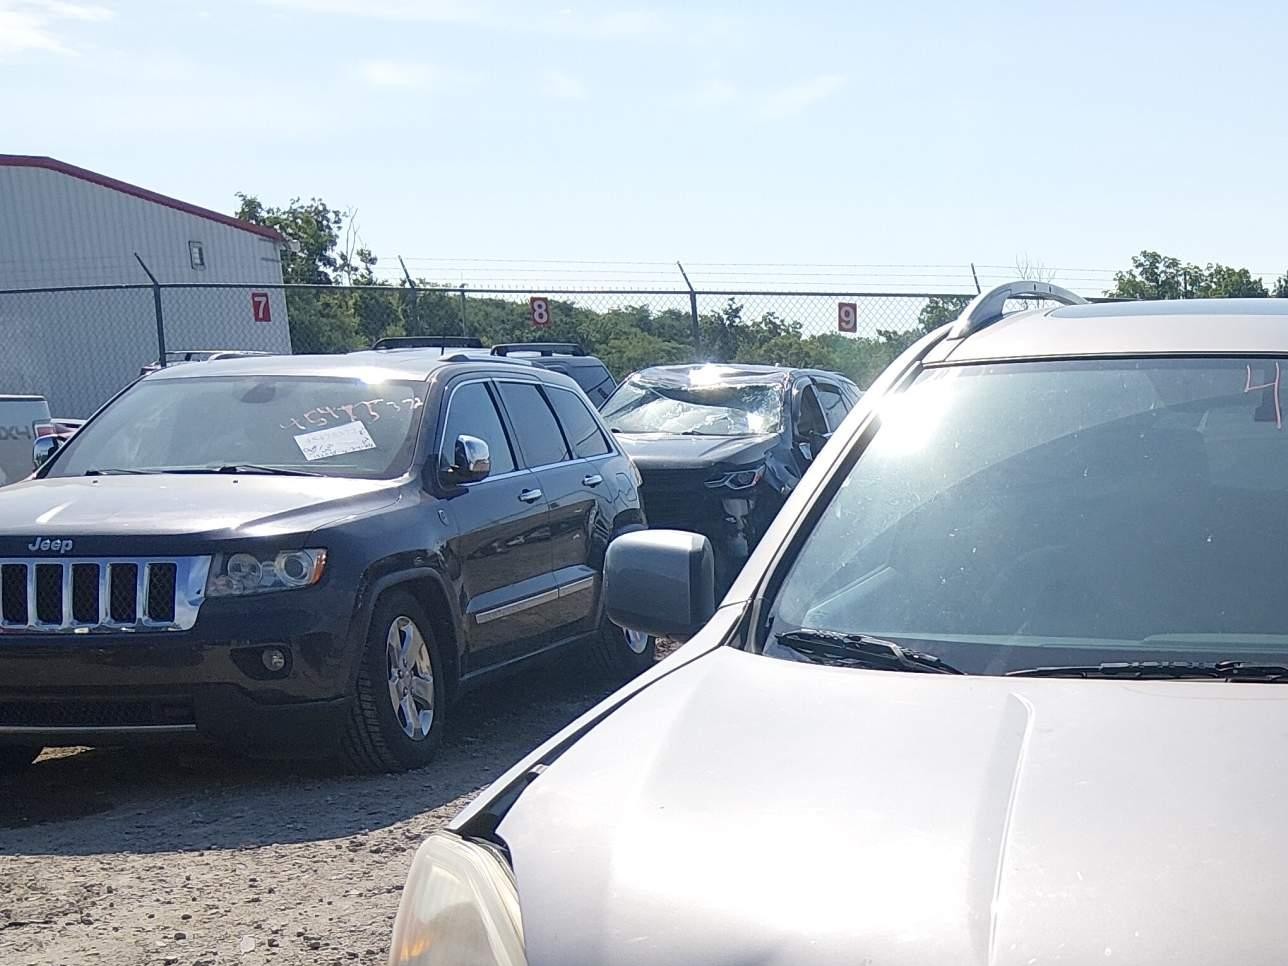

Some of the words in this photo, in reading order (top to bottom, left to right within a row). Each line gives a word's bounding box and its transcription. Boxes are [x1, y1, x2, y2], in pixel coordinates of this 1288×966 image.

[254, 296, 267, 319] 7
[533, 300, 548, 323] 8
[840, 305, 855, 329] 9
[28, 536, 73, 554] Jeep
